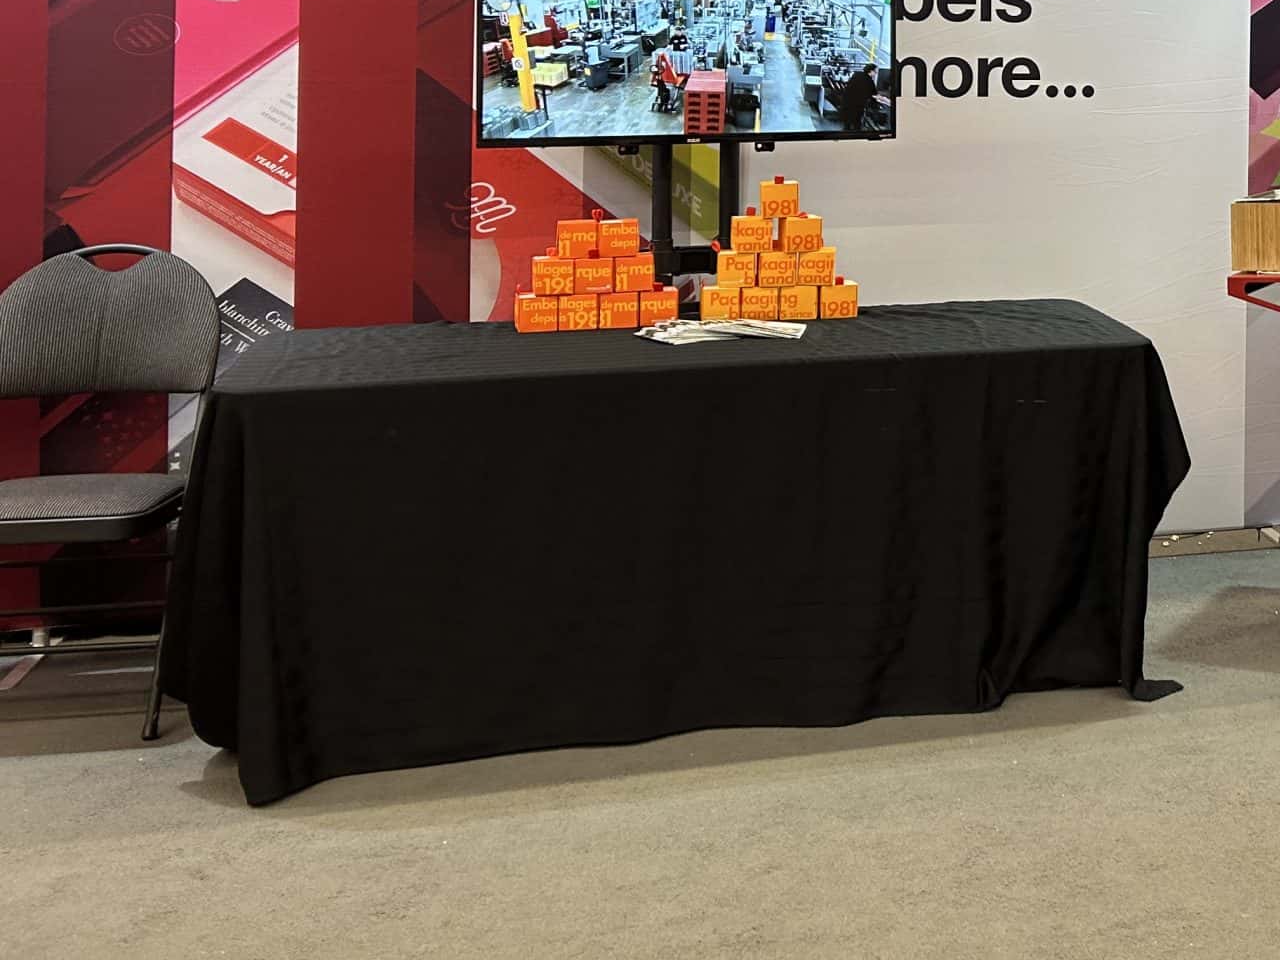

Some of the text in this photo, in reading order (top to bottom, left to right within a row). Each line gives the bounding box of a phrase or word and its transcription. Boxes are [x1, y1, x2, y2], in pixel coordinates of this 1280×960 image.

[763, 199, 798, 217] 1981
[786, 234, 824, 249] 1981
[822, 301, 857, 317] 1981
